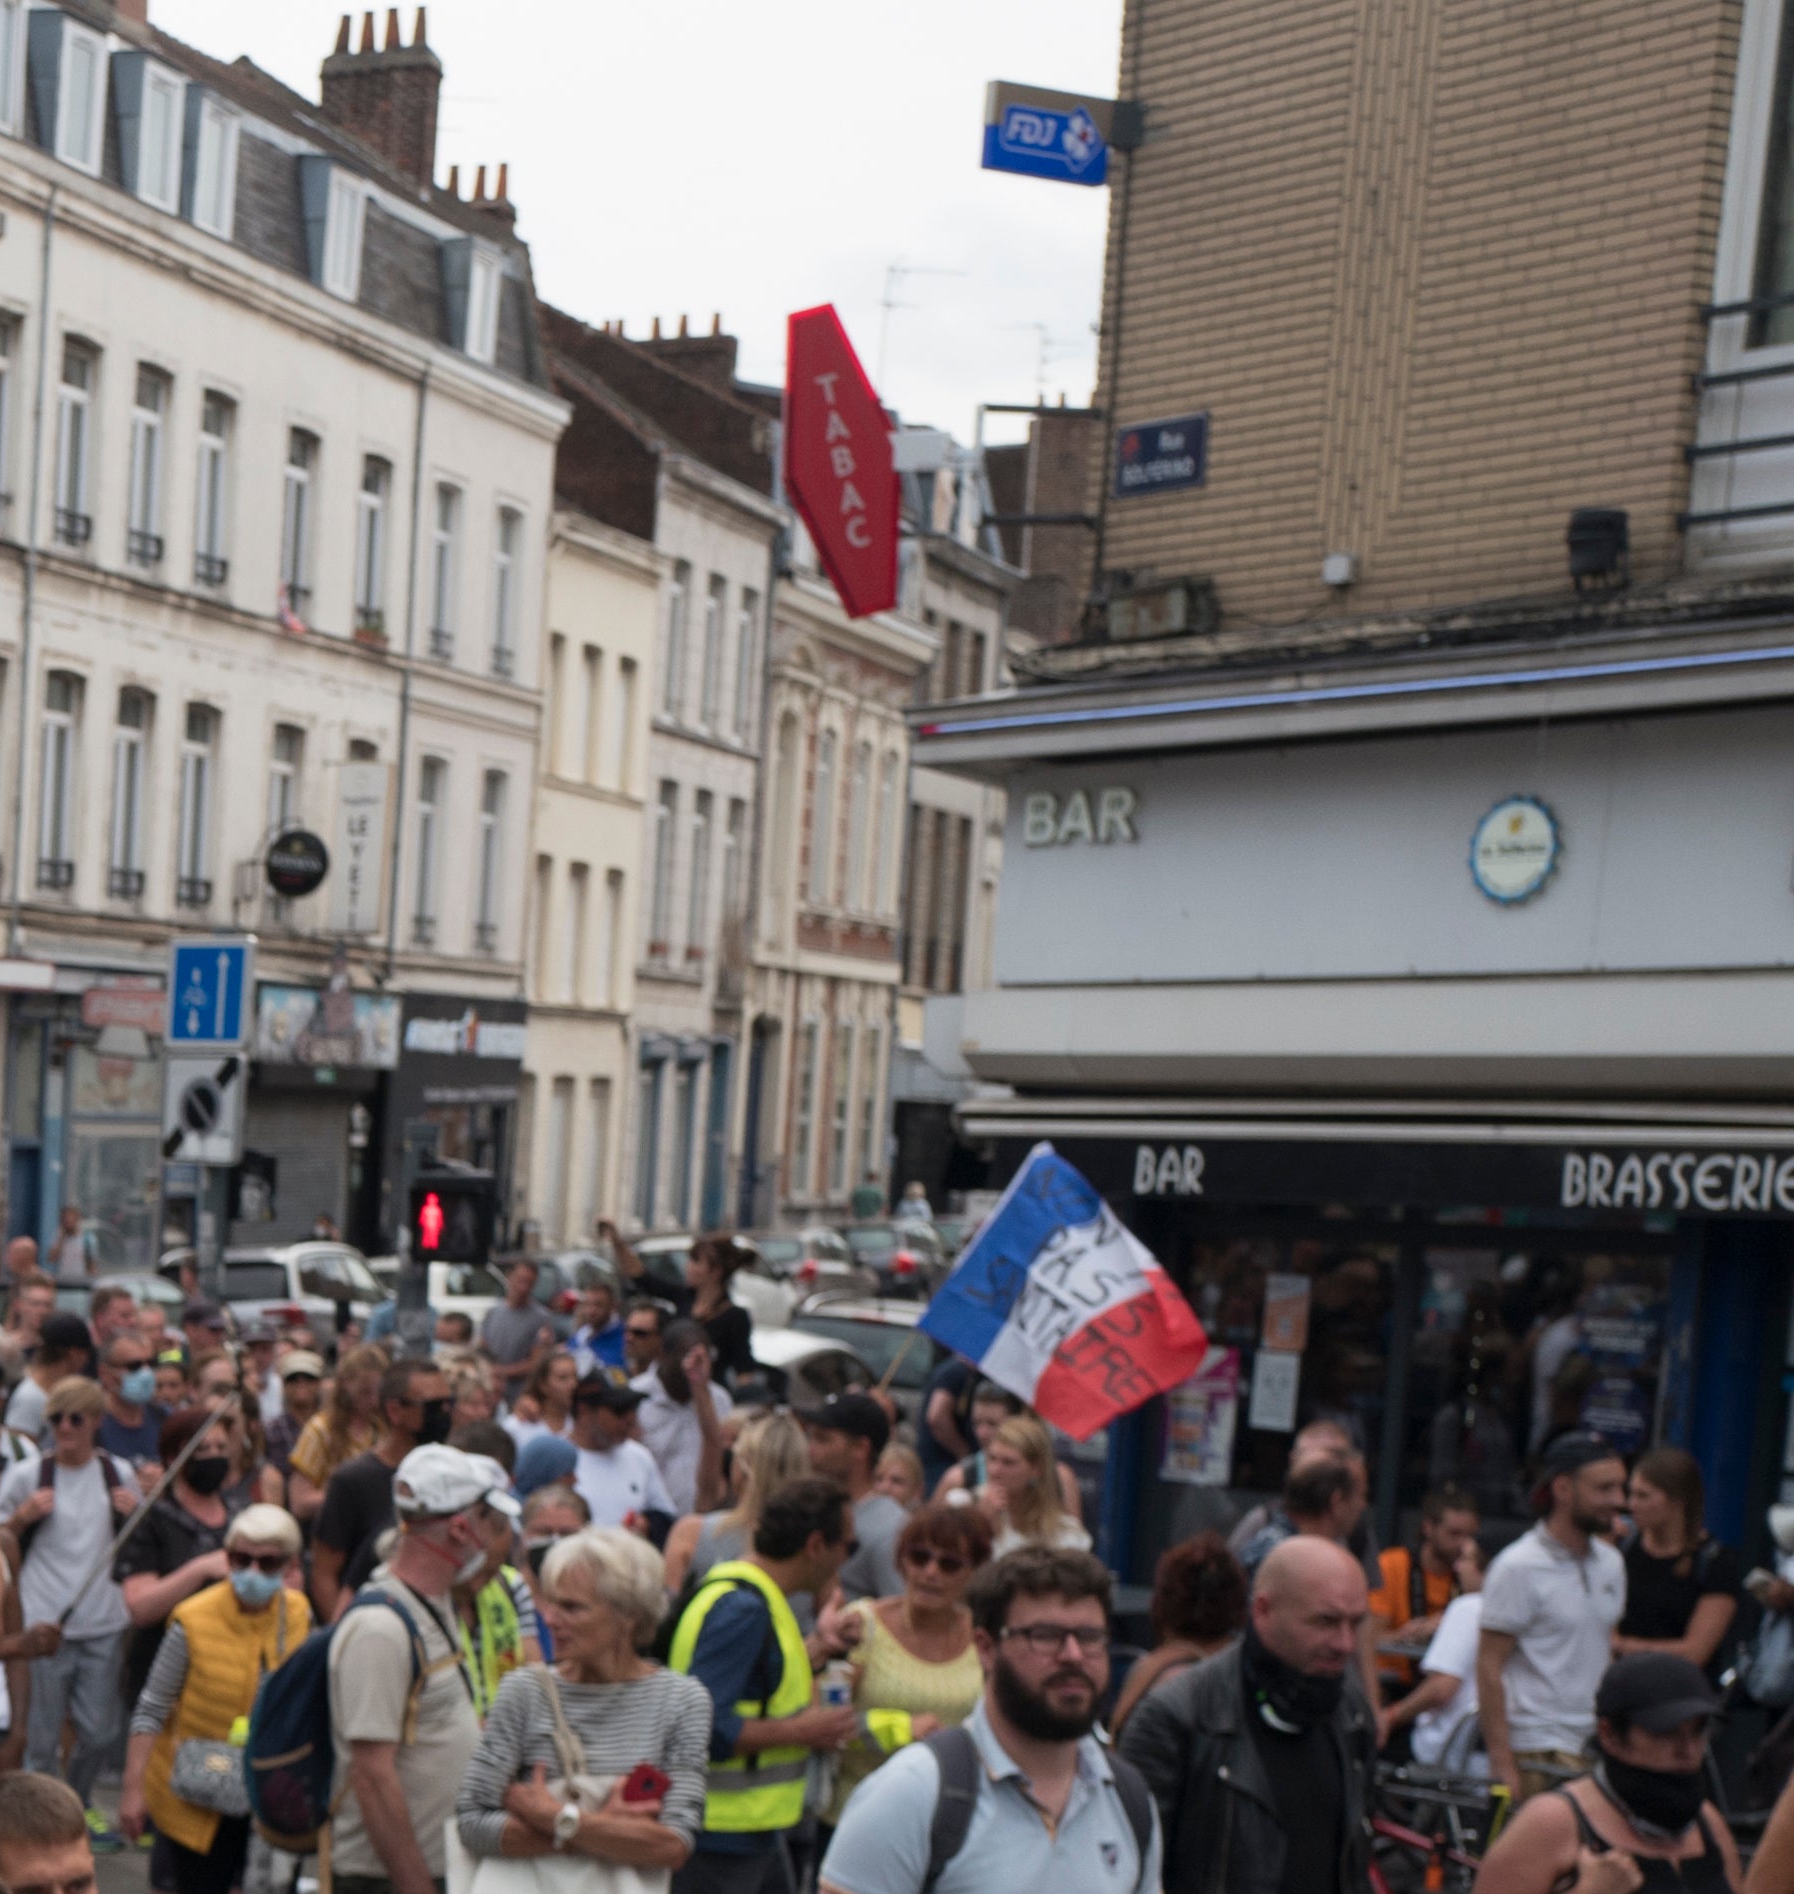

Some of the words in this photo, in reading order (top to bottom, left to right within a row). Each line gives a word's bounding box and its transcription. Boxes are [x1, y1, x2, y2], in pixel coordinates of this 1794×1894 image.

[1006, 112, 1058, 147] FDJ
[813, 371, 873, 548] TABAC
[1024, 787, 1137, 846] BAR
[1133, 1144, 1204, 1195] BAR
